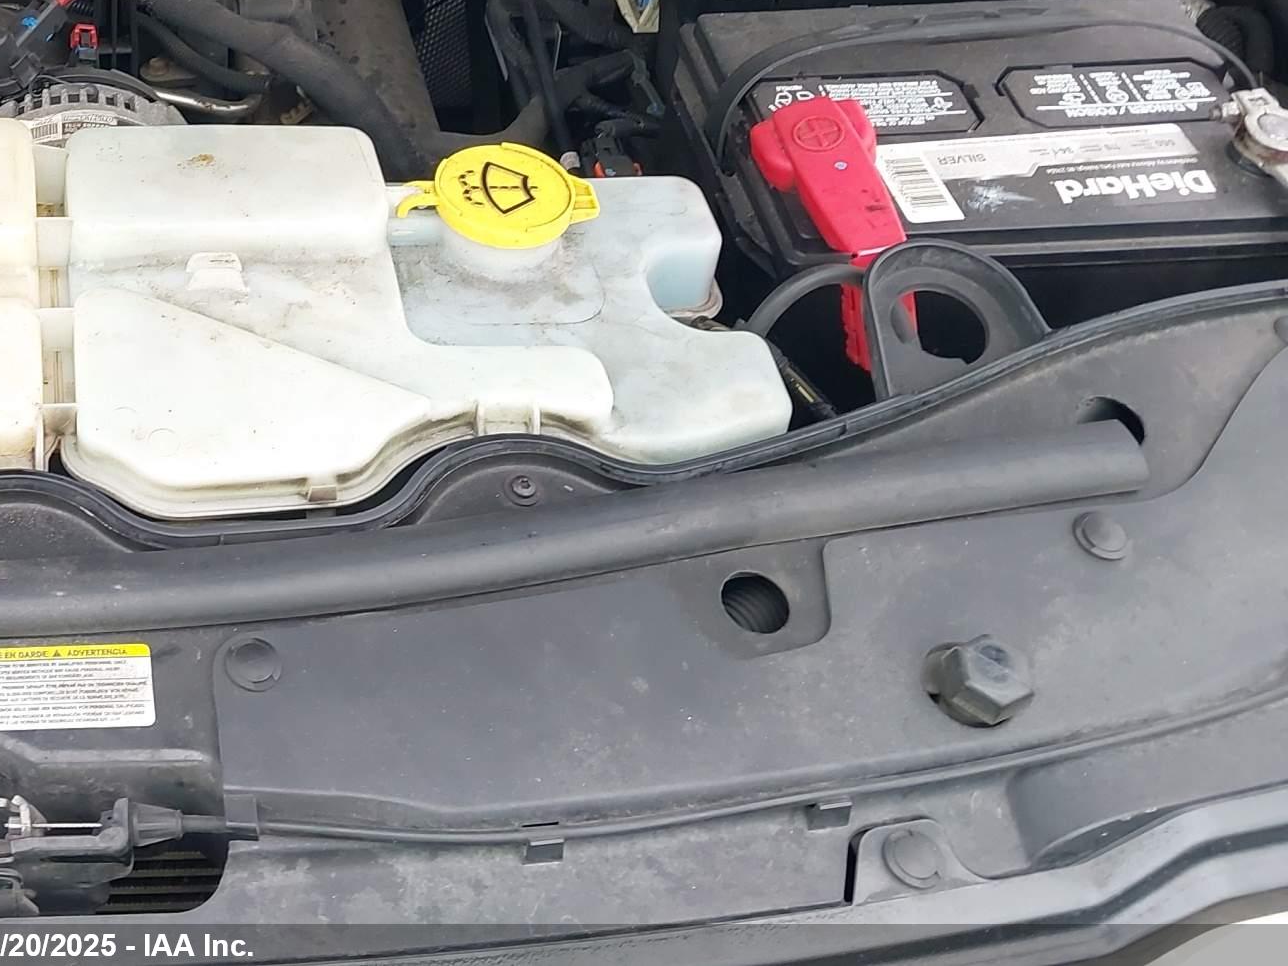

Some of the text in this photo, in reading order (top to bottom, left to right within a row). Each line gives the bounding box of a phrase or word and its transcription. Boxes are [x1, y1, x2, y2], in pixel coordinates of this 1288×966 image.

[937, 152, 987, 166] SILVER
[1054, 169, 1216, 204] DieHard
[5, 651, 16, 659] EN
[18, 650, 49, 659] GARDE
[67, 648, 128, 657] ADVERTENCIA
